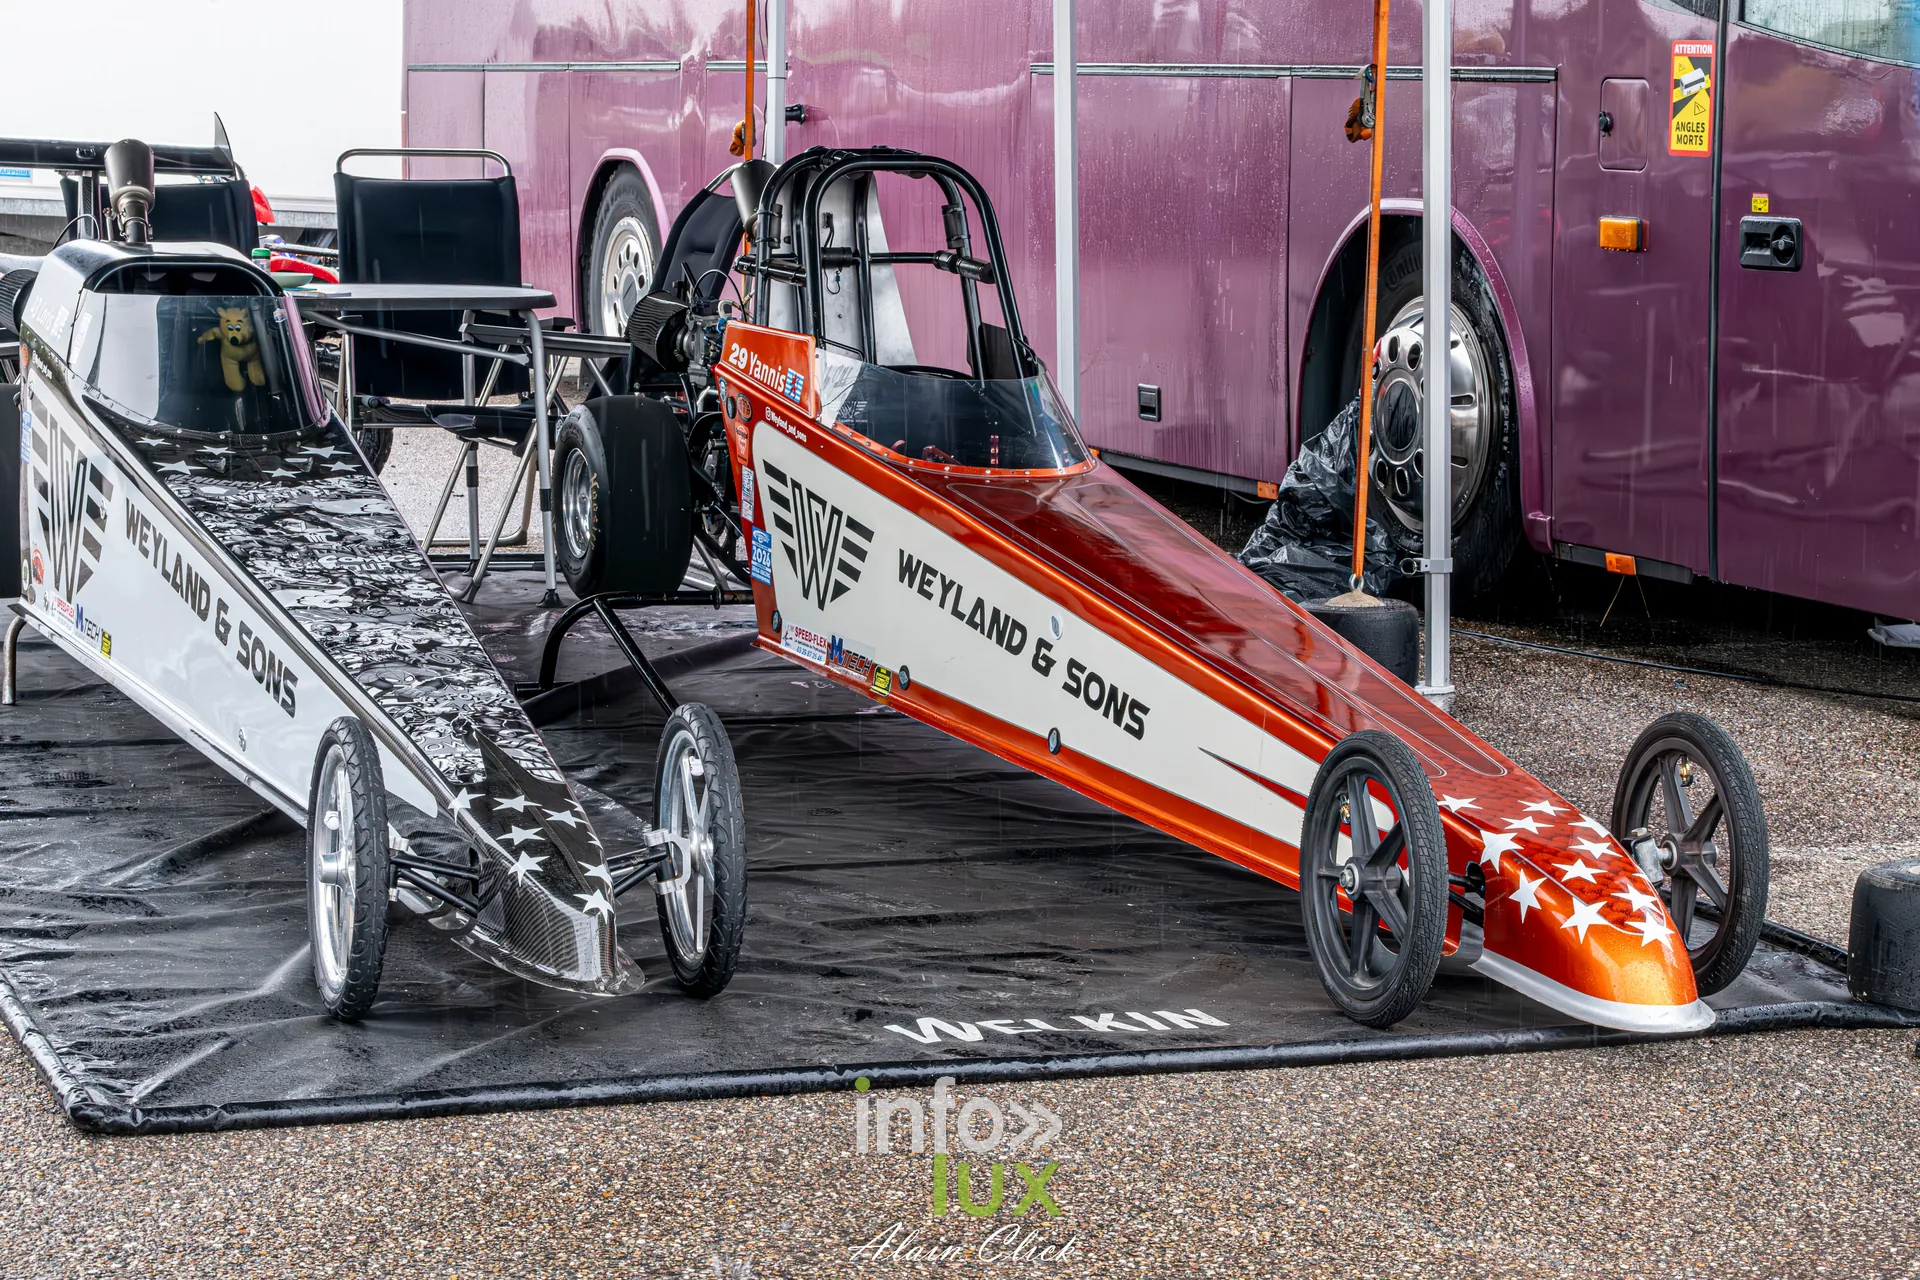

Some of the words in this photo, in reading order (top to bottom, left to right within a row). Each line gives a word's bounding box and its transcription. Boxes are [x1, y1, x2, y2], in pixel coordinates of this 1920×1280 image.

[1674, 43, 1713, 54] ATTENTION
[1675, 121, 1705, 133] ANGLES
[1676, 134, 1703, 146] MORTS
[729, 343, 748, 369] 29
[749, 351, 786, 392] Yannis
[753, 546, 770, 567] 2026
[125, 497, 211, 622] WEYLAND
[236, 620, 299, 718] SONS
[795, 627, 827, 648] SPEED-FLEX
[899, 548, 1028, 656] WEYLAND
[1062, 657, 1151, 740] SONS
[883, 1008, 1231, 1044] WELKIN
